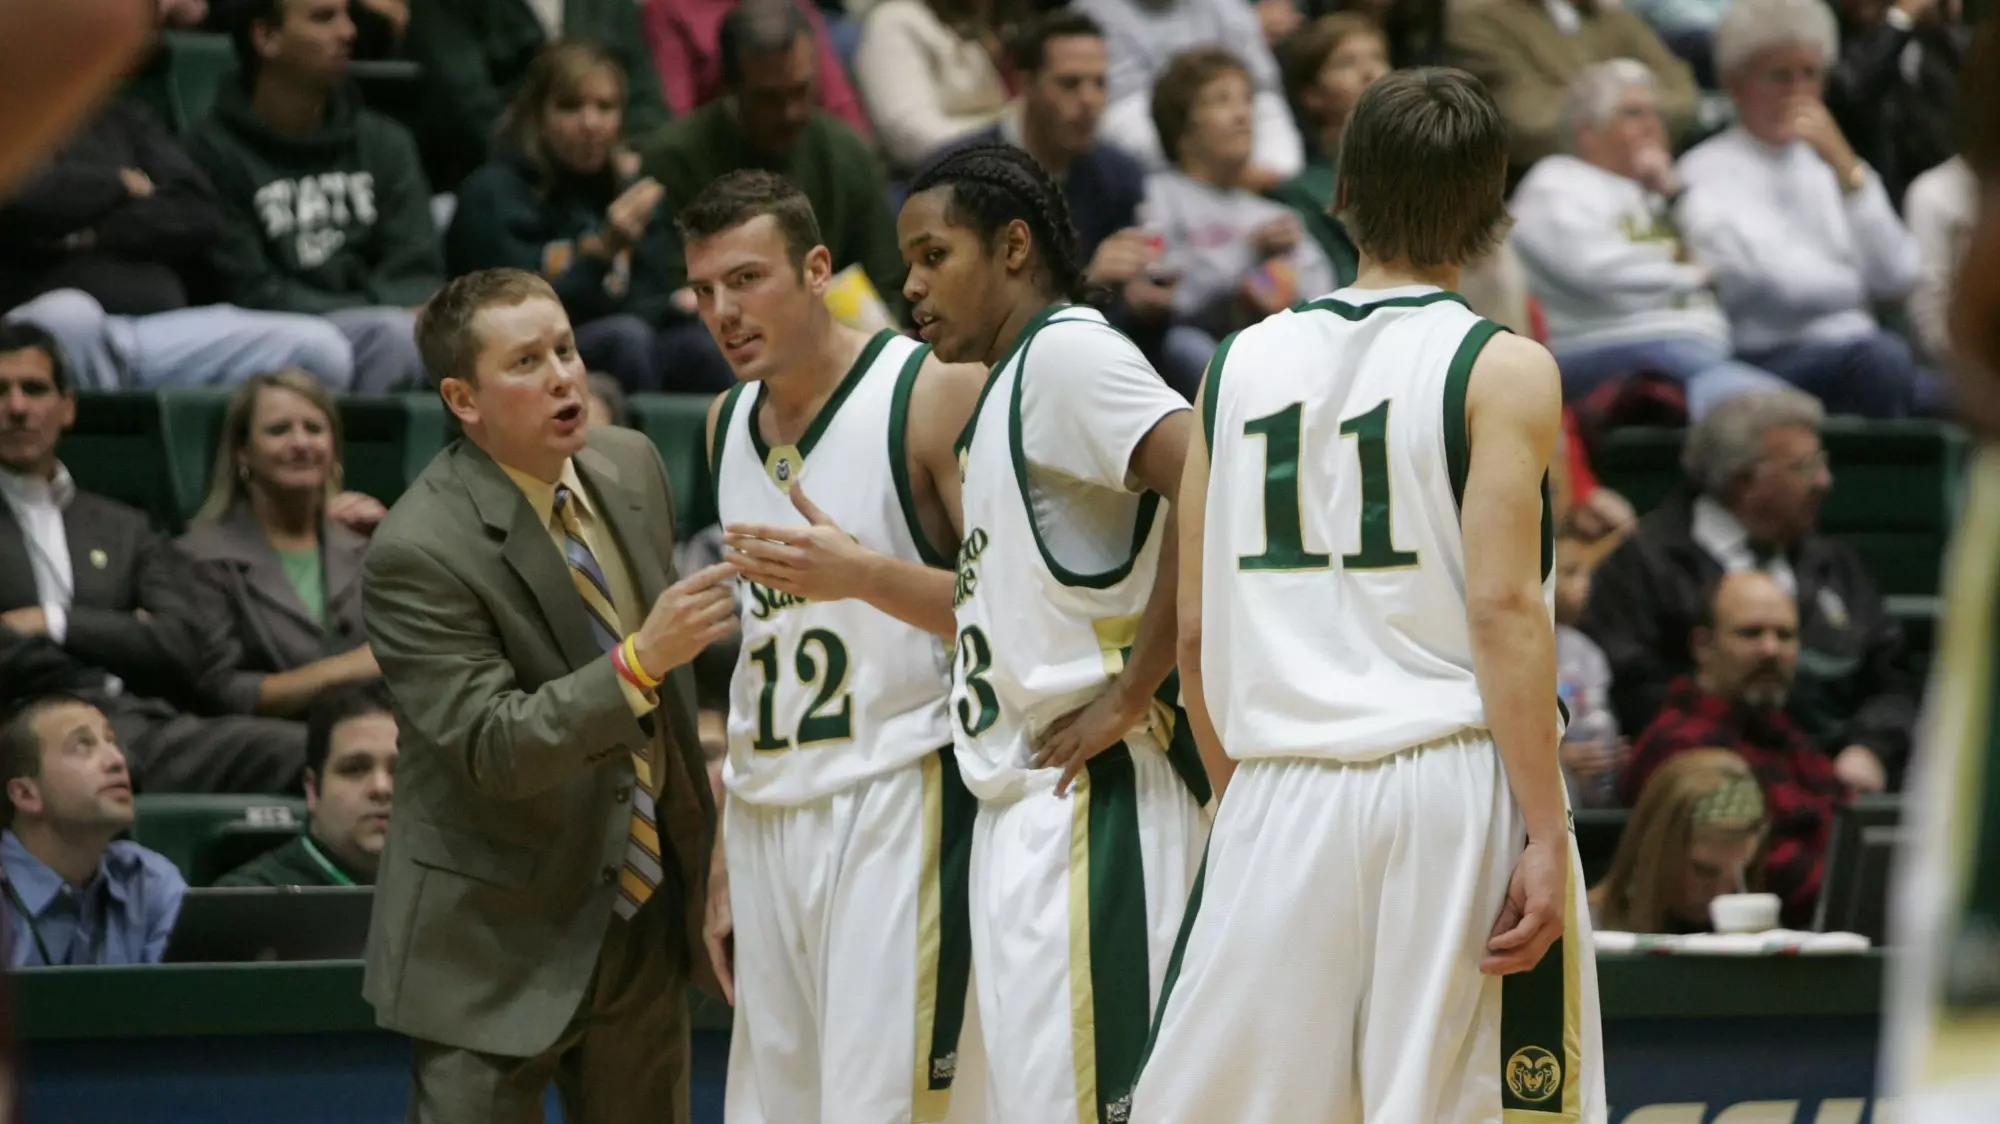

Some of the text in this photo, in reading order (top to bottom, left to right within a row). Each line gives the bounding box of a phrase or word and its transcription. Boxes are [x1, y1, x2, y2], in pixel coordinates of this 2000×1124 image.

[254, 171, 378, 238] STATE
[1237, 398, 1420, 572] 11
[751, 627, 854, 752] 12
[951, 624, 1001, 739] 3
